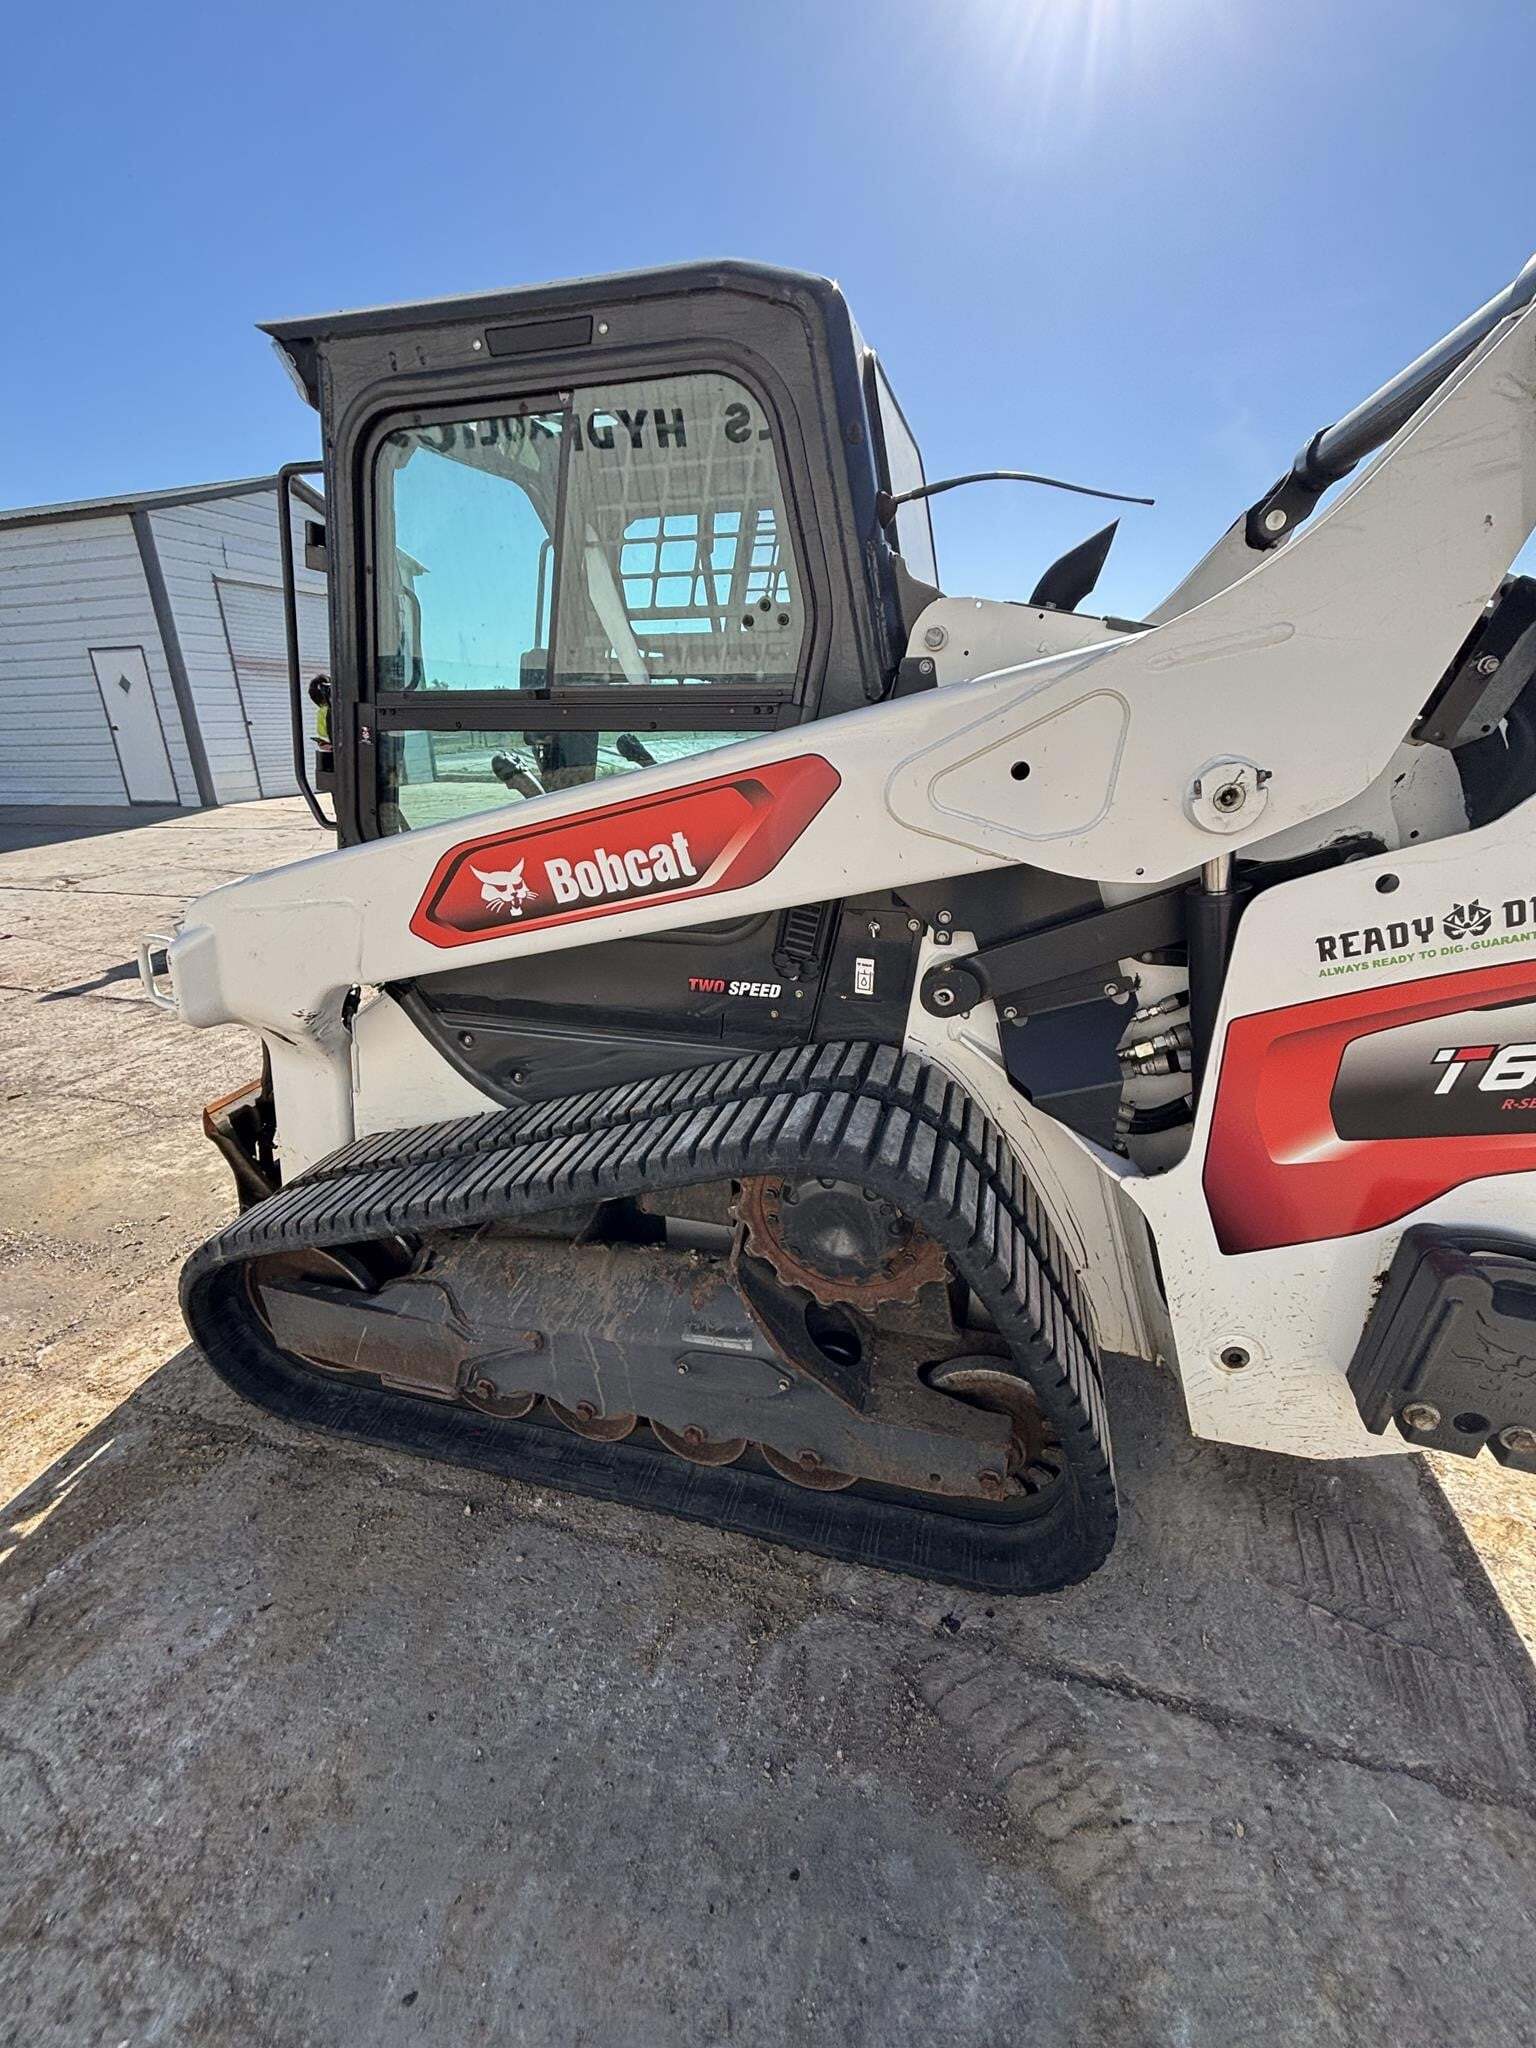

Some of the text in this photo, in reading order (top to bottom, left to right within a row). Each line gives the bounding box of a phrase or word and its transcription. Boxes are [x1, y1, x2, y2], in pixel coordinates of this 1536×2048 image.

[543, 831, 697, 904] Bobcat
[1314, 916, 1434, 962] READY
[1318, 960, 1370, 978] ALWAYS
[1372, 952, 1416, 969] READY
[1419, 948, 1437, 960] TO
[688, 978, 782, 998] TWO SPEED
